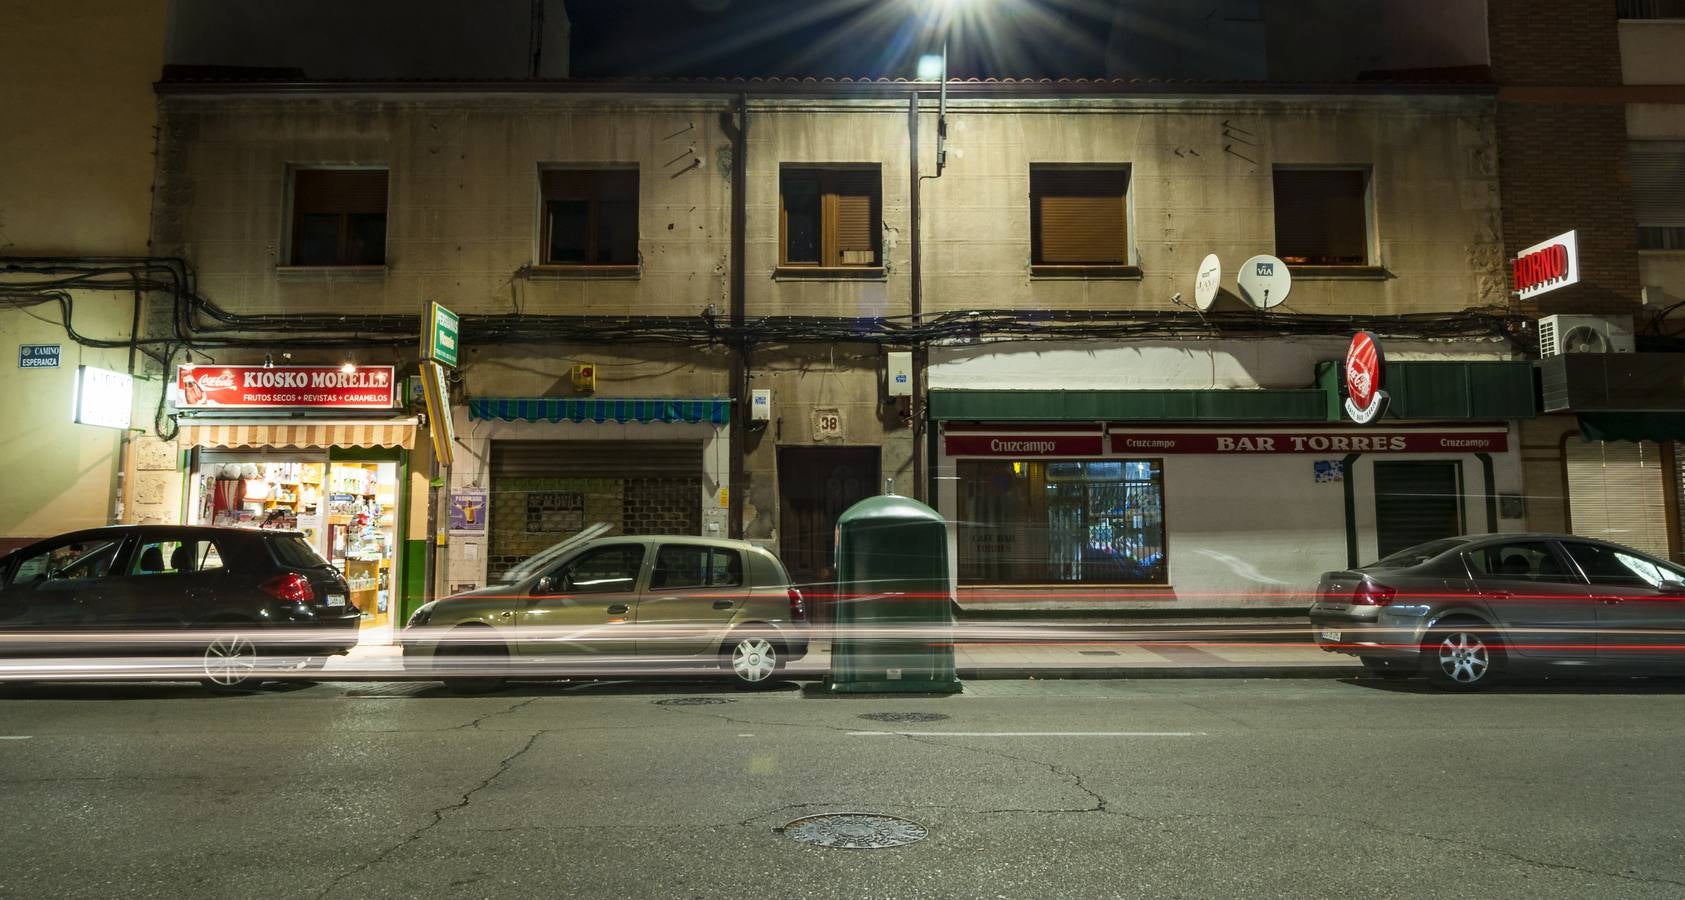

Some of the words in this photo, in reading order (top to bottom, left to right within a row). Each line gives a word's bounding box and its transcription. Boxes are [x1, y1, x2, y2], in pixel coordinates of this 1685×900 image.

[1513, 243, 1561, 290] HORNO
[34, 347, 59, 355] CAMINO
[22, 358, 57, 366] ESPERANZA
[198, 373, 236, 389] Coca-Cola
[243, 372, 308, 388] KIOSKO
[311, 371, 389, 388] MORELLE
[243, 394, 272, 402] FRUTOS
[272, 394, 296, 402] SECOS
[303, 394, 337, 402] REVISTAS
[344, 394, 388, 402] CARAMELOS
[821, 416, 838, 430] 38
[990, 438, 1056, 453] Cruzcampo
[1126, 438, 1175, 448] Cruzcampo
[1216, 436, 1276, 450] BAR
[1290, 436, 1407, 450] TORRES
[1440, 438, 1489, 448] Cruzcampo
